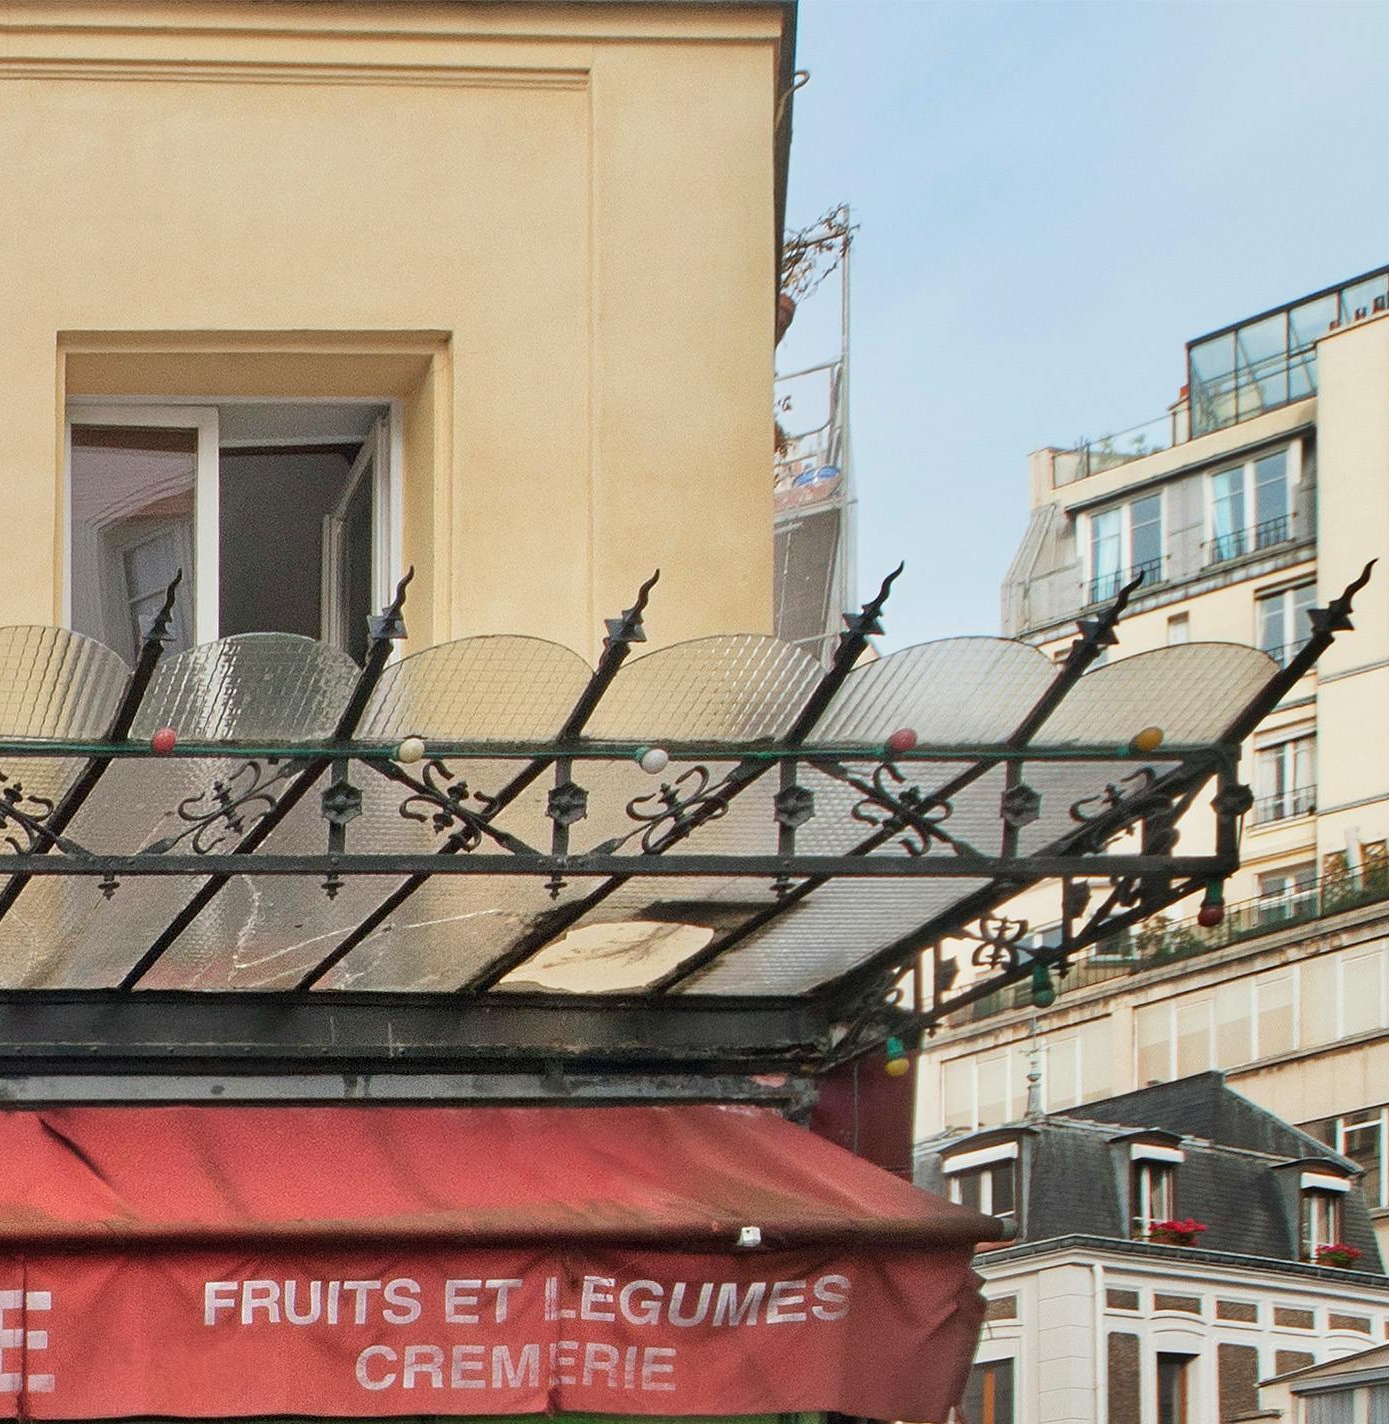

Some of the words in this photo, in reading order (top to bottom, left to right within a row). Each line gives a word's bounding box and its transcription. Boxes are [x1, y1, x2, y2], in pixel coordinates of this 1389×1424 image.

[203, 1278, 423, 1328] FRUITS
[444, 1277, 524, 1325] ET
[544, 1274, 854, 1328] LEGUMES
[355, 1341, 678, 1392] CREMERIE
